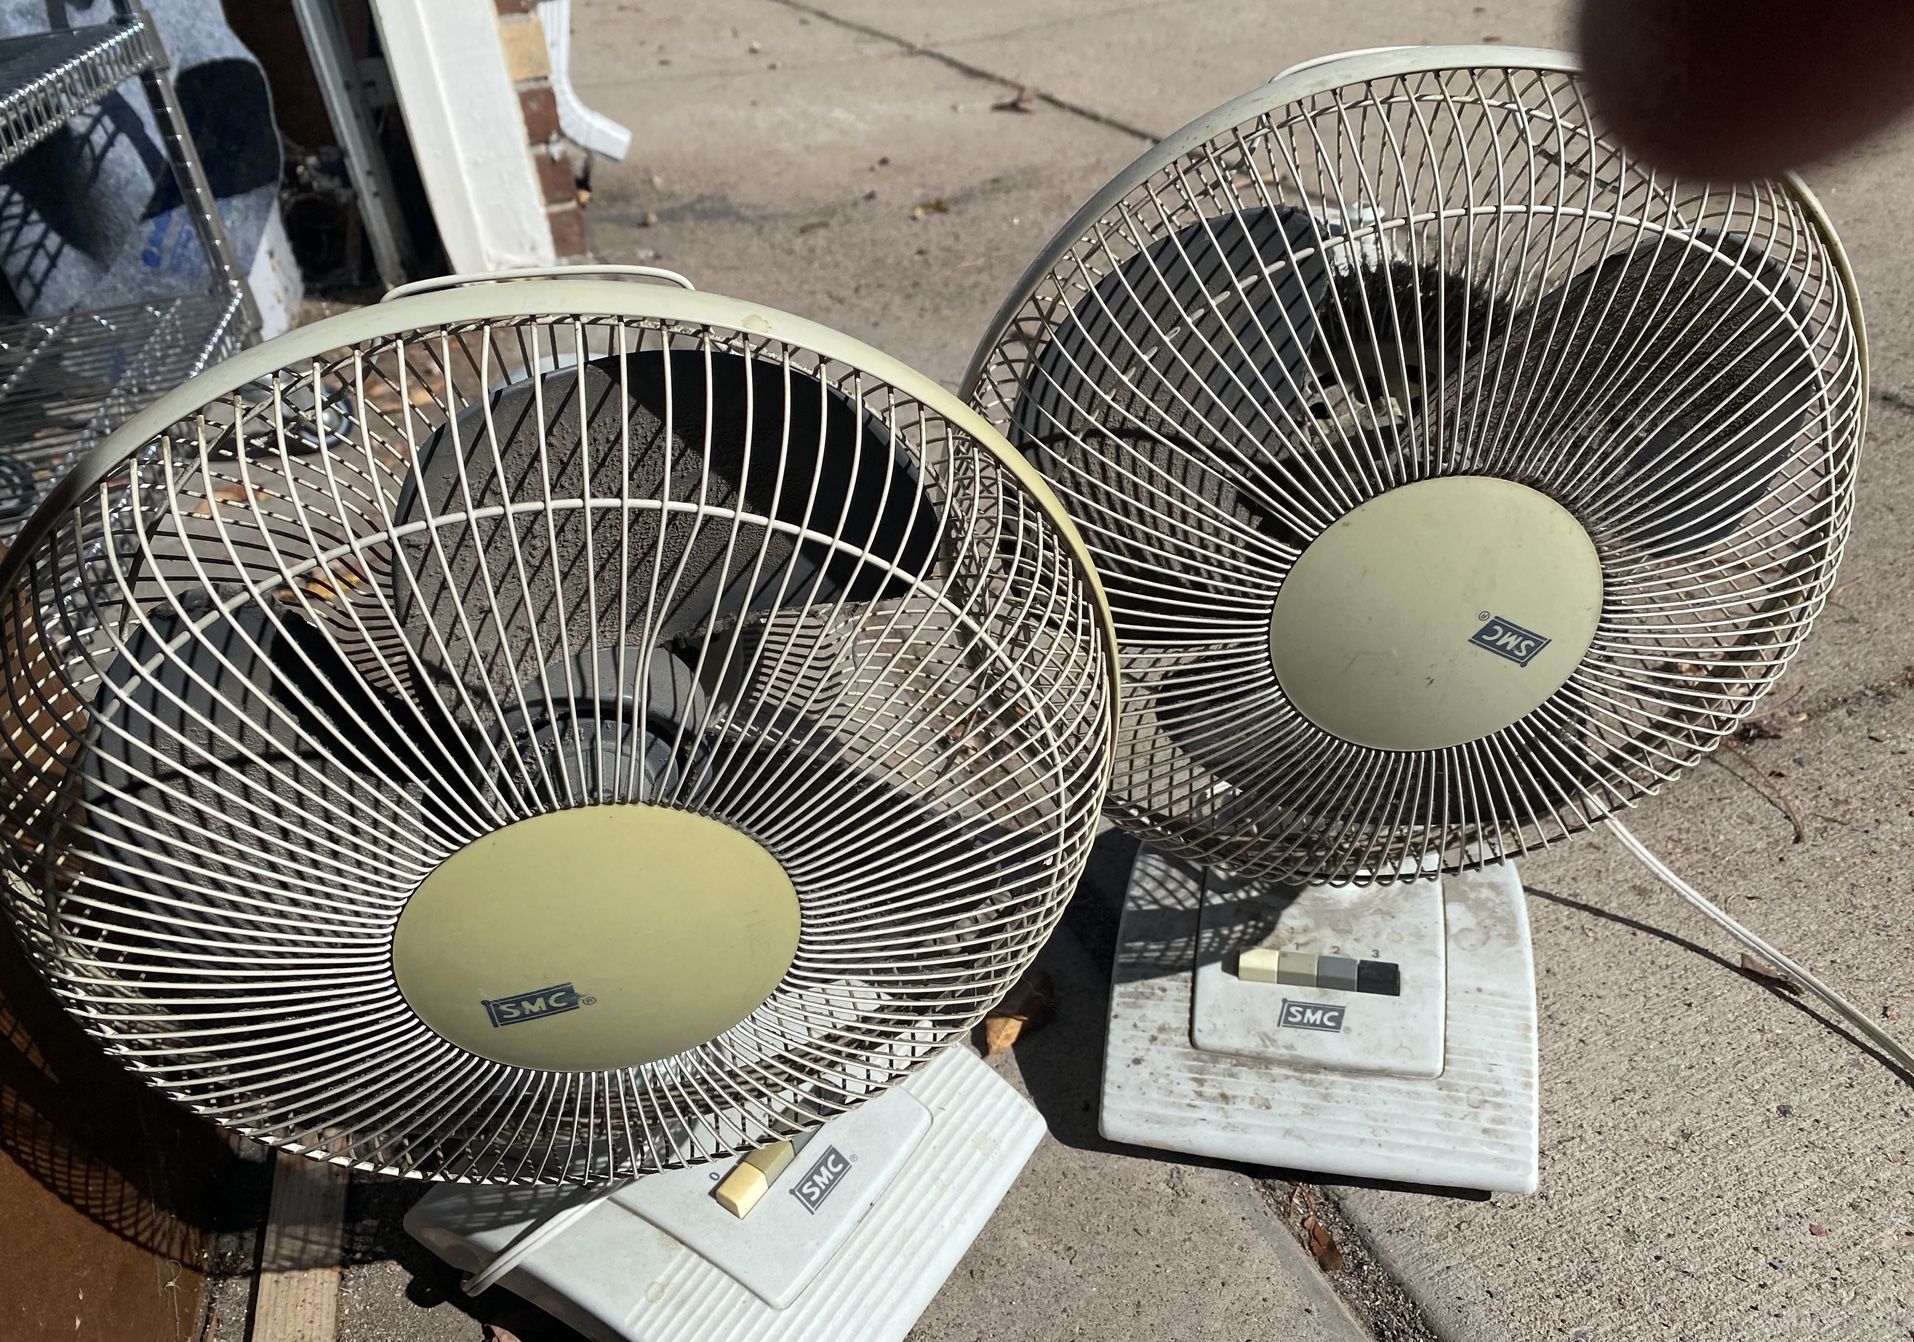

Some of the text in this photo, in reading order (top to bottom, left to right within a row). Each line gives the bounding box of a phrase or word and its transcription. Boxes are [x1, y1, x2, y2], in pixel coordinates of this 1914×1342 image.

[1482, 625, 1535, 656] SMC
[1331, 946, 1340, 955] 2
[1371, 949, 1380, 958] 3
[500, 991, 568, 1018] SMC
[1288, 1006, 1339, 1026] SMC
[802, 1154, 843, 1200] SMC
